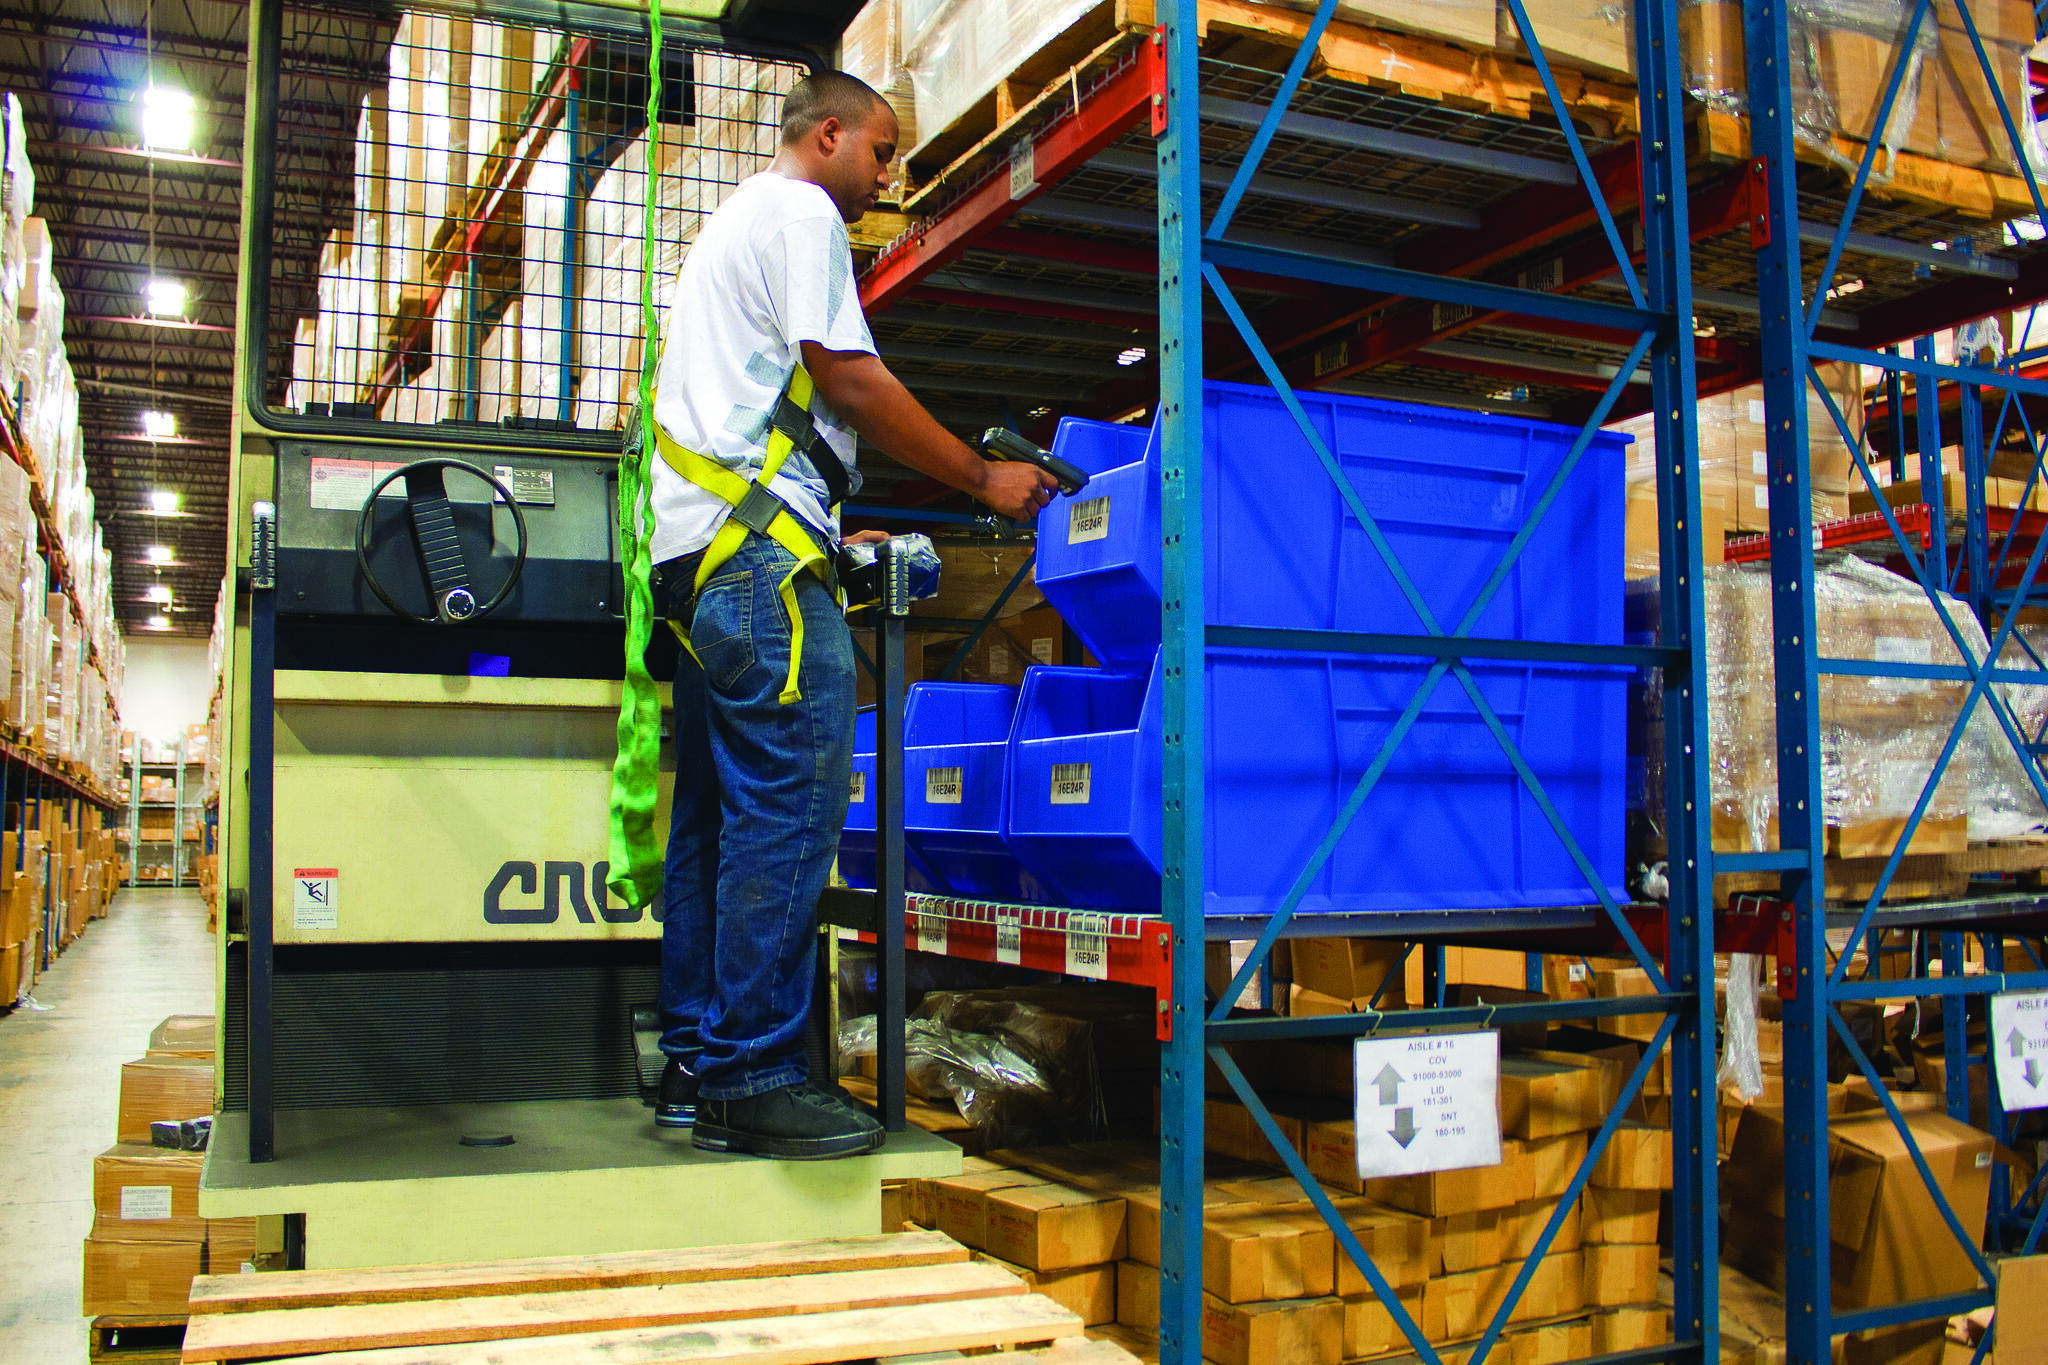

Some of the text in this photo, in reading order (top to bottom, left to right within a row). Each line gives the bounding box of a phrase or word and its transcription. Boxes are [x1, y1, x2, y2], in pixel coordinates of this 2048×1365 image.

[1077, 516, 1103, 533] 16E24R
[932, 784, 957, 796] 16E24R
[1058, 781, 1084, 794] 16E24R
[1074, 951, 1100, 966] 16E24R
[2016, 999, 2041, 1010] AISLE
[1408, 1041, 1434, 1052] AISLE
[1445, 1040, 1455, 1049] 16
[1428, 1056, 1448, 1065] COV
[1413, 1069, 1462, 1081] 91000-93000
[1431, 1086, 1445, 1095] LID
[1441, 1112, 1457, 1122] SNT
